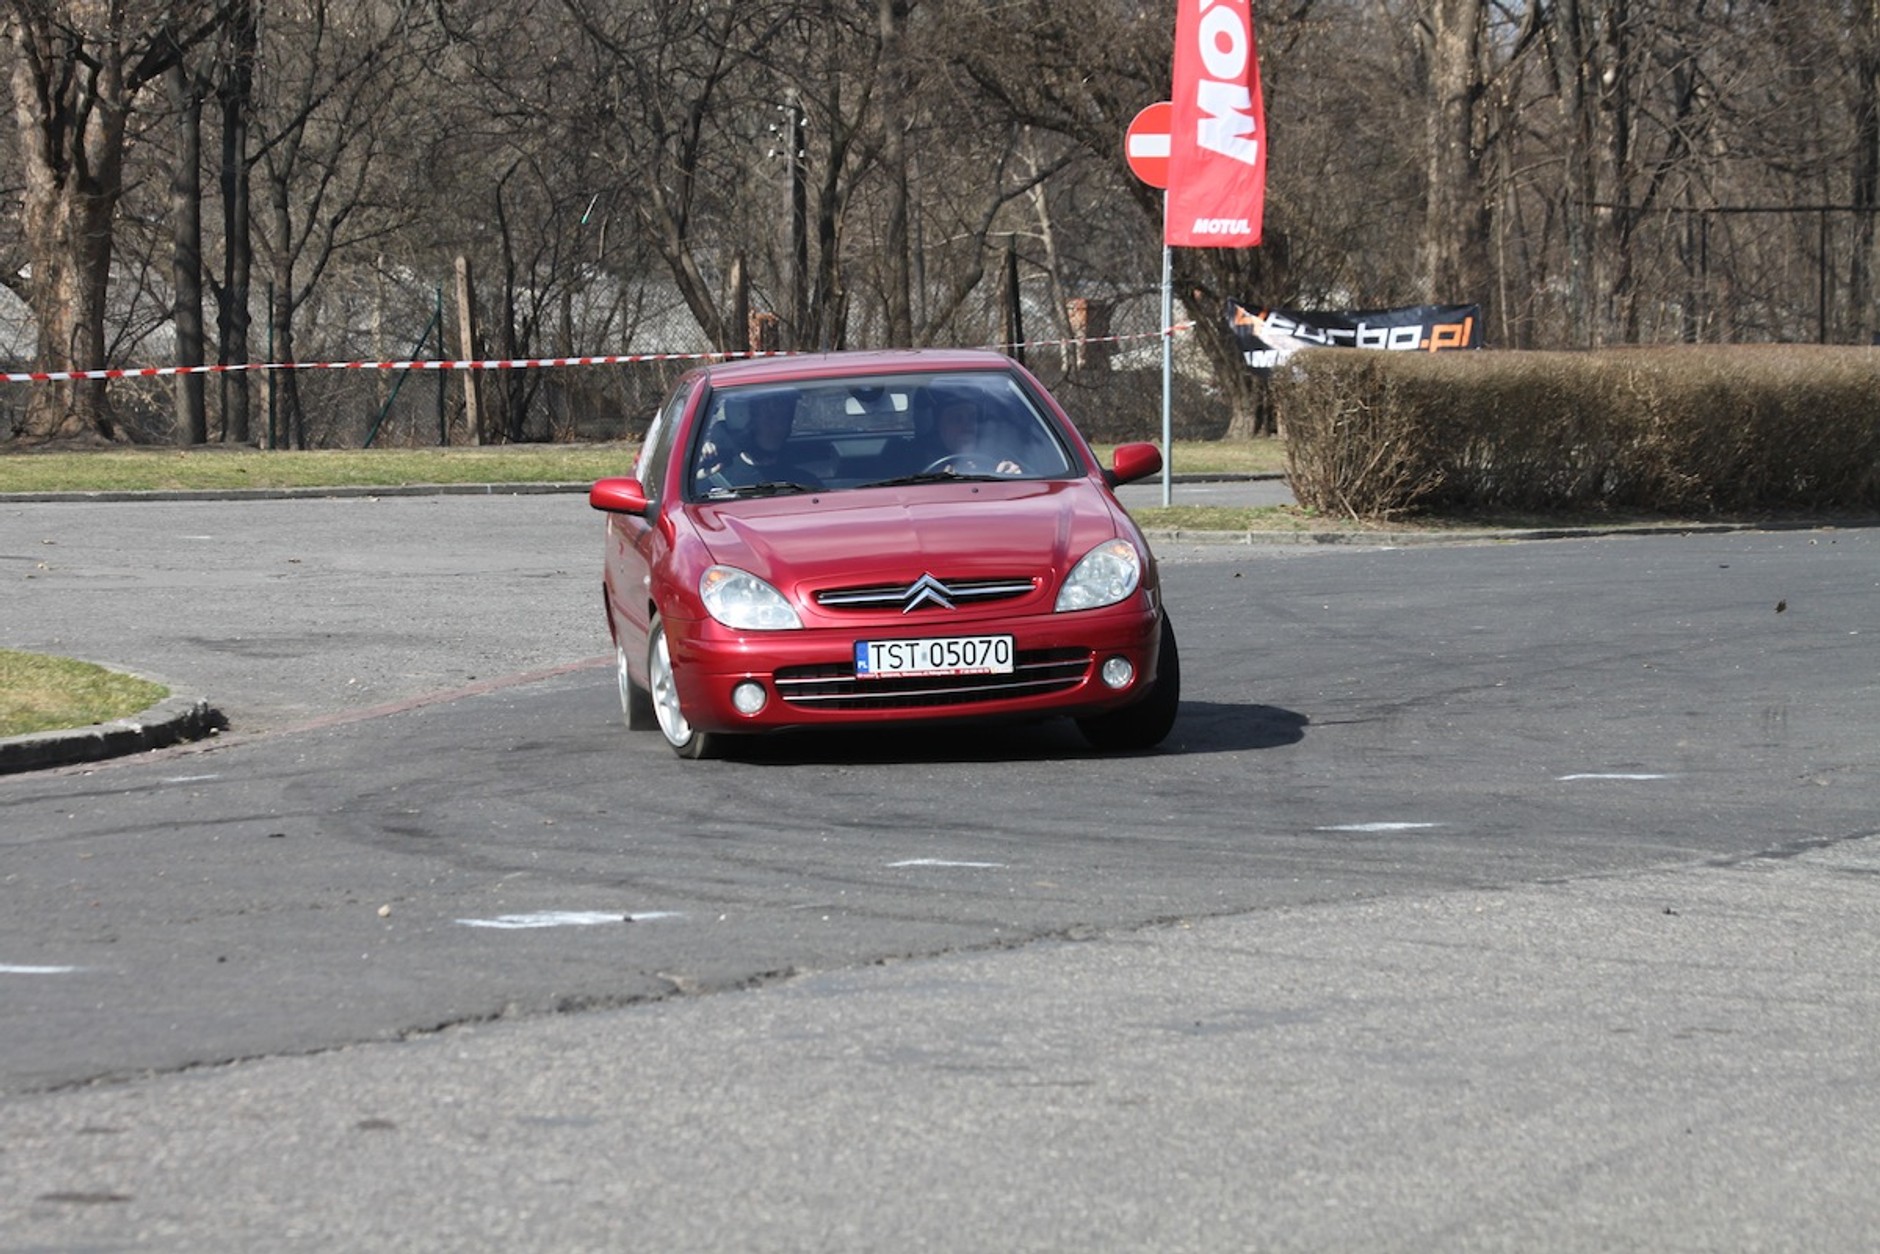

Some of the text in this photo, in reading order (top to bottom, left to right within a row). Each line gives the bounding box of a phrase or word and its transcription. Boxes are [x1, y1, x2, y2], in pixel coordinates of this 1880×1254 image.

[1197, 0, 1258, 166] MO
[1192, 218, 1251, 234] MOTUL
[857, 660, 868, 669] PL
[871, 639, 1009, 670] TST 05070
